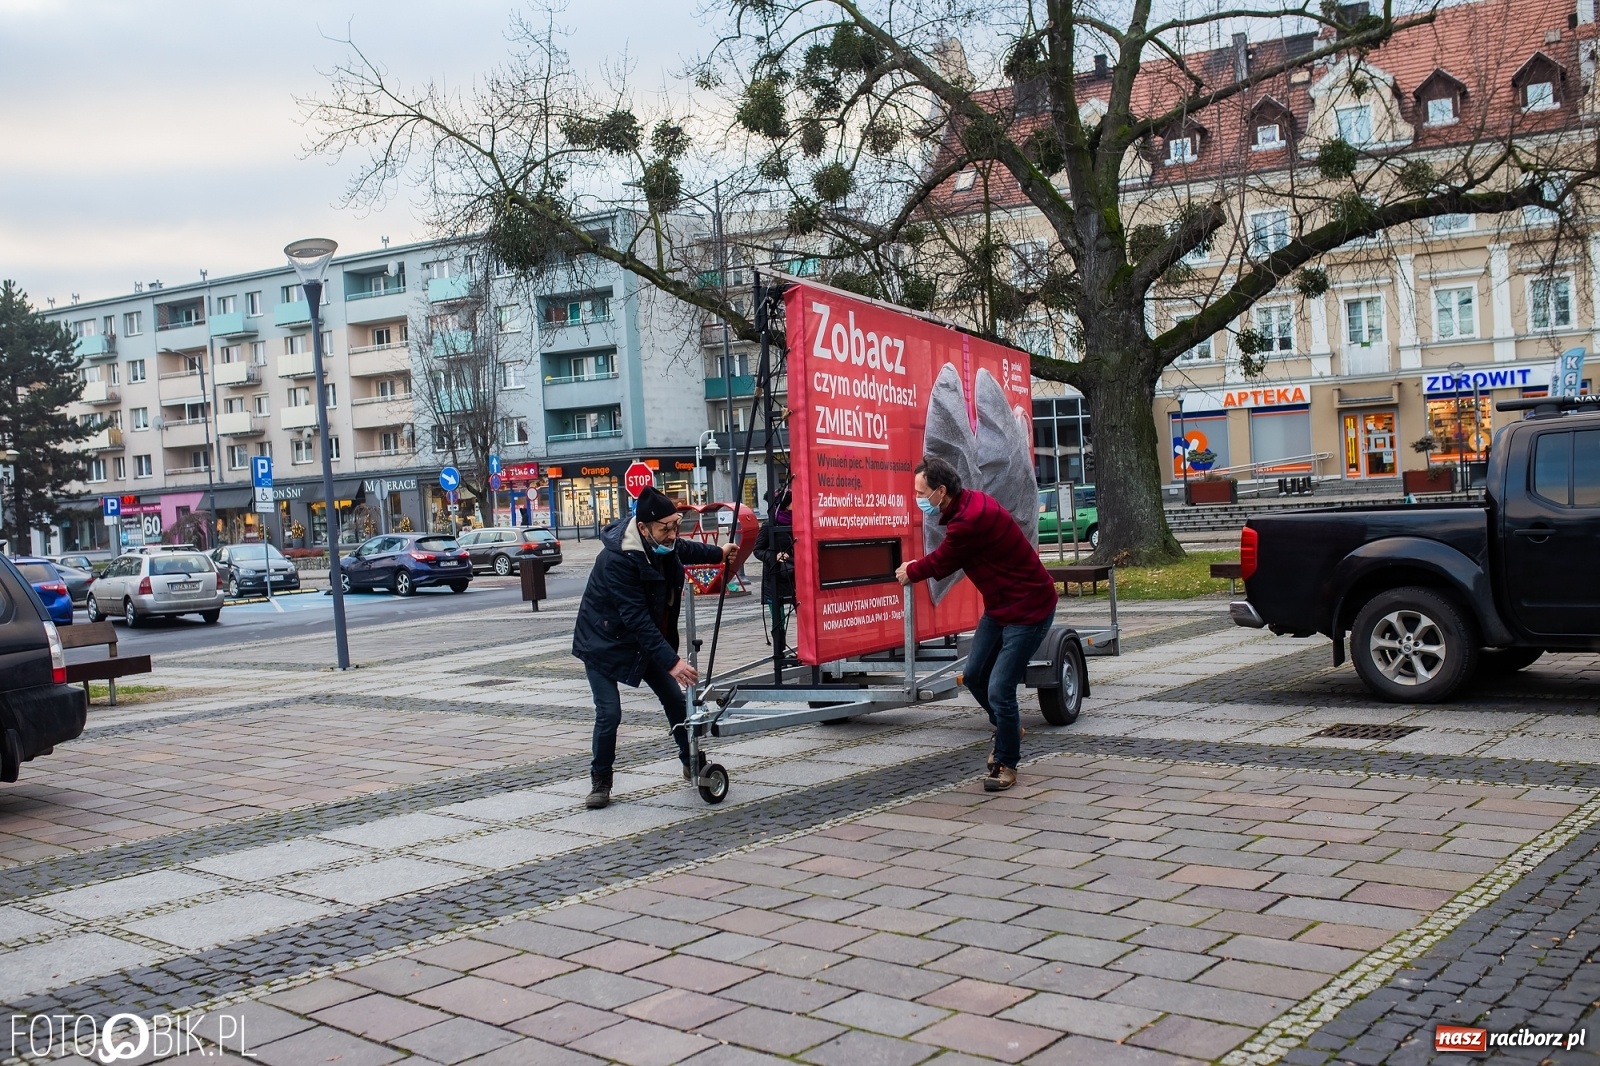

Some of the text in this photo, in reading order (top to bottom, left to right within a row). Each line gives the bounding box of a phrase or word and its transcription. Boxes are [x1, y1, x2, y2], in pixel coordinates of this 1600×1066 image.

[812, 301, 906, 375] Zobacz
[813, 372, 917, 408] czym oddychasz!
[1426, 369, 1531, 392] ZDROWIT
[1223, 387, 1306, 407] APTEKA
[815, 405, 888, 440] ZMIEŃ TO!
[257, 459, 269, 479] P
[581, 466, 610, 476] Orange
[675, 461, 694, 471] Orange
[817, 453, 913, 474] Wymień piec. Namów sąsiada!
[365, 479, 417, 492] MERACE
[628, 475, 651, 487] STOP
[835, 474, 863, 491] dotację.
[107, 498, 118, 514] P
[818, 492, 904, 508] Zadzwoń! tel. 22 340 40 80
[818, 512, 910, 529] www.czystepowietrze.gov.pl
[822, 594, 900, 615] AKTUALNY STAN POWIETRZA
[823, 618, 843, 631] NORMA
[843, 615, 866, 628] DOBOWA
[865, 614, 877, 624] DLA
[875, 612, 883, 621] PM
[883, 611, 889, 621] 10
